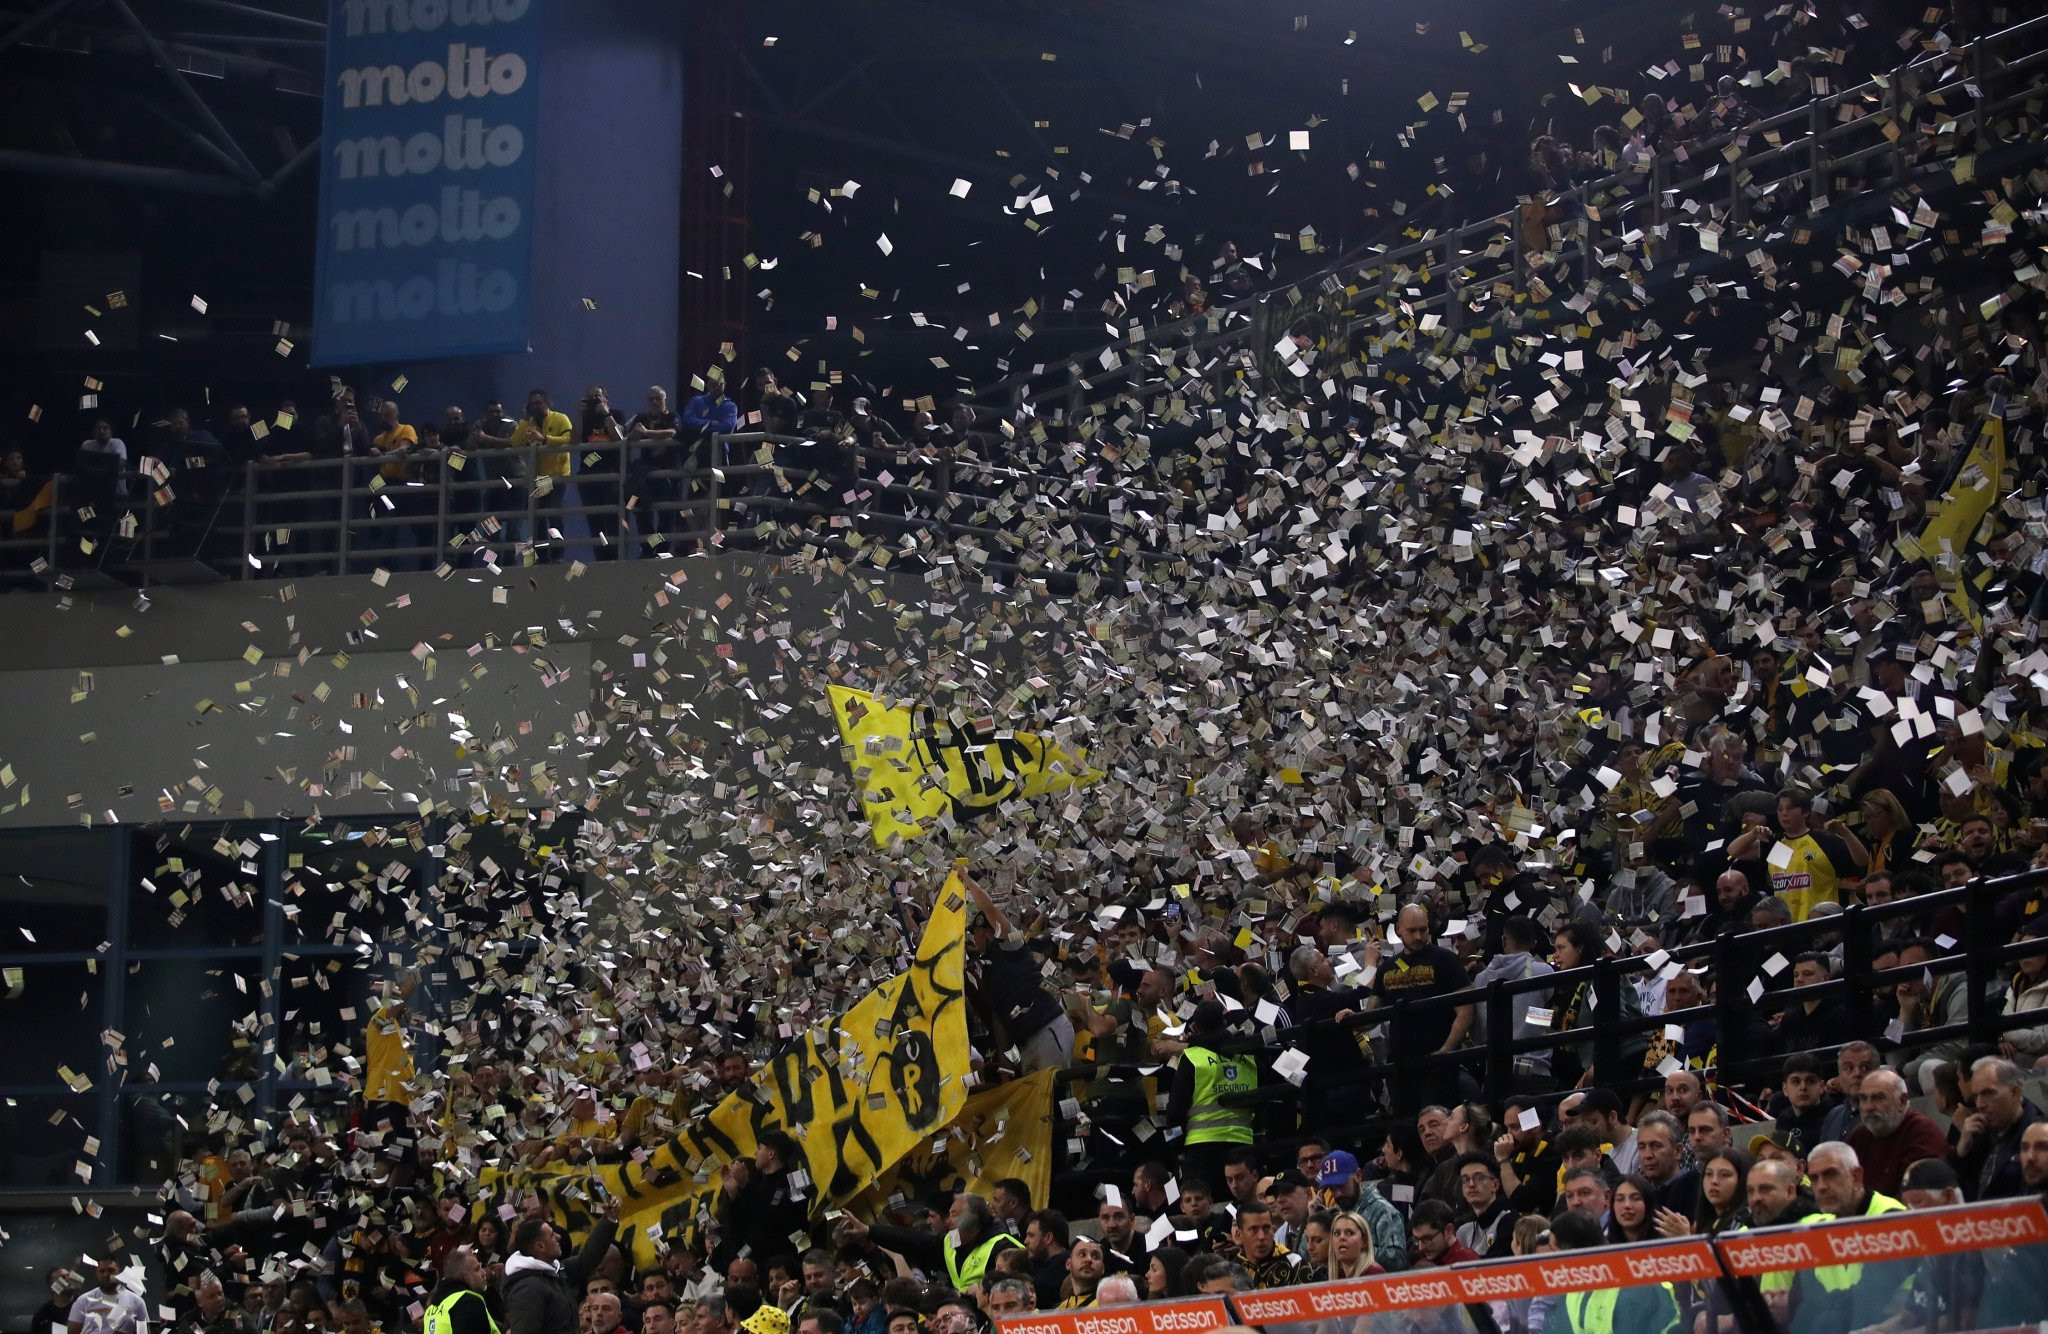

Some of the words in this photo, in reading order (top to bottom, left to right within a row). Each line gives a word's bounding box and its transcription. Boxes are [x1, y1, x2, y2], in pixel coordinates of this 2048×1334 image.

[338, 42, 527, 109] molto
[334, 113, 524, 180] molto
[331, 185, 521, 250] molto
[328, 257, 518, 322] molto
[1207, 1054, 1249, 1067] ALA
[1212, 1083, 1250, 1092] SECURITY
[1324, 1158, 1338, 1174] 31
[1725, 1241, 1812, 1269] betsson
[1826, 1228, 1920, 1258] betsson
[1936, 1213, 2035, 1245] betsson
[1239, 1297, 1301, 1320] betsson
[1309, 1289, 1374, 1312] betsson
[1383, 1279, 1452, 1304] betsson
[1458, 1272, 1529, 1297] betsson
[1539, 1262, 1615, 1288] betsson
[1625, 1252, 1706, 1279] betsson
[1073, 1315, 1138, 1334] betsson
[1150, 1309, 1218, 1331] betsson
